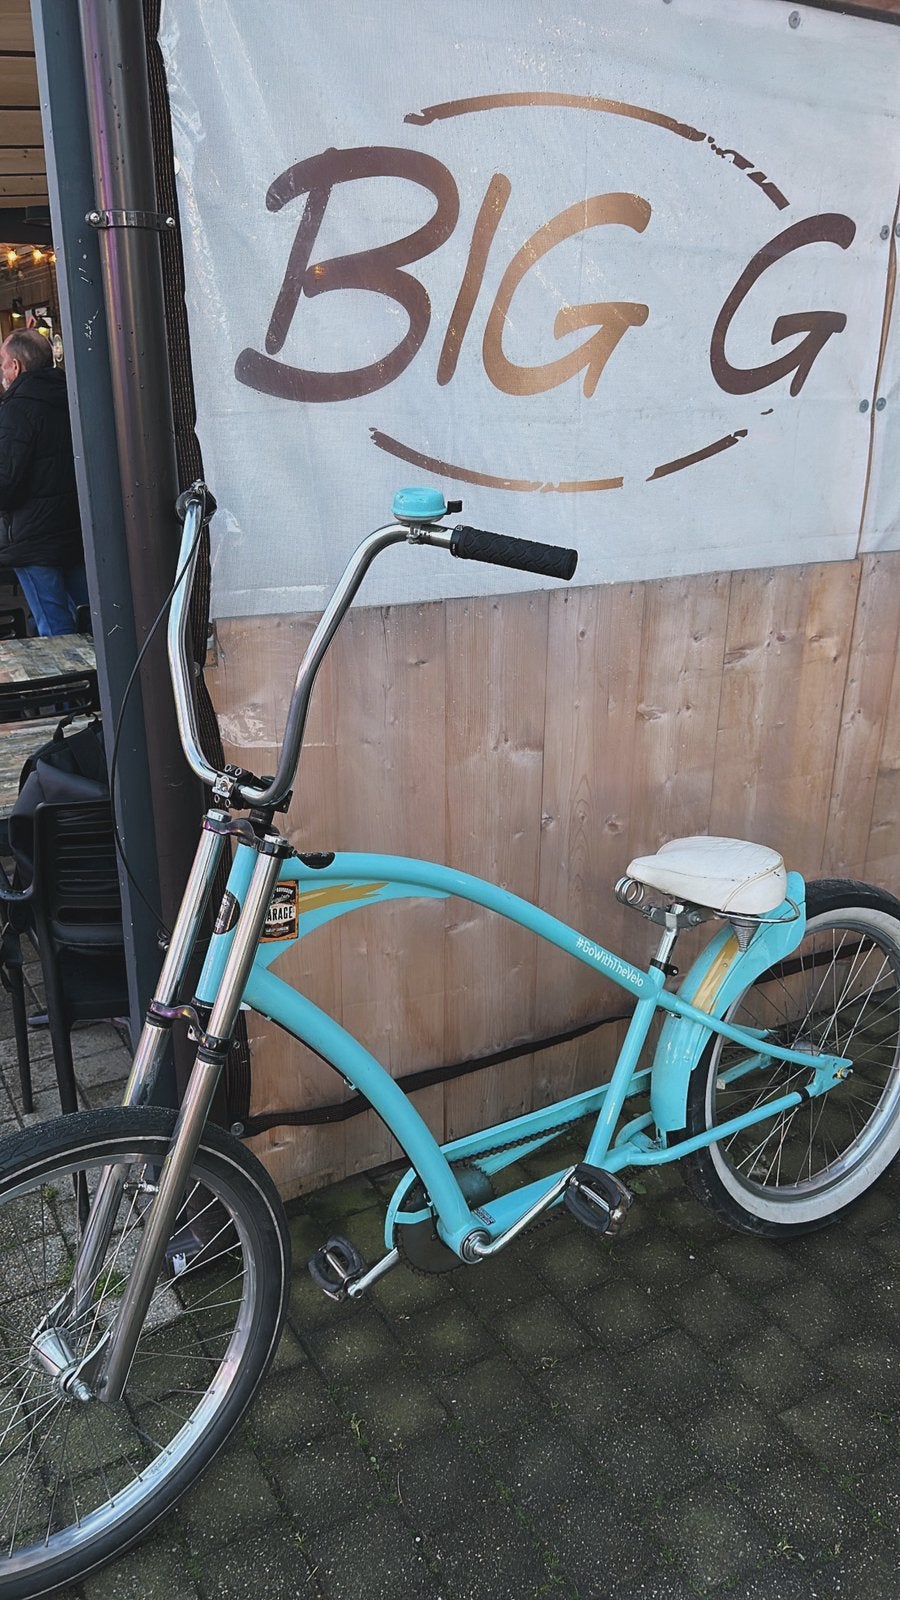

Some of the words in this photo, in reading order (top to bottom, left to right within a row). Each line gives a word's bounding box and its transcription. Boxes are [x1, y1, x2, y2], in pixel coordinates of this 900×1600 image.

[235, 146, 651, 402] BIG
[710, 213, 856, 397] G
[266, 906, 292, 922] ARAGE
[575, 937, 644, 987] #GoWithTheVelo
